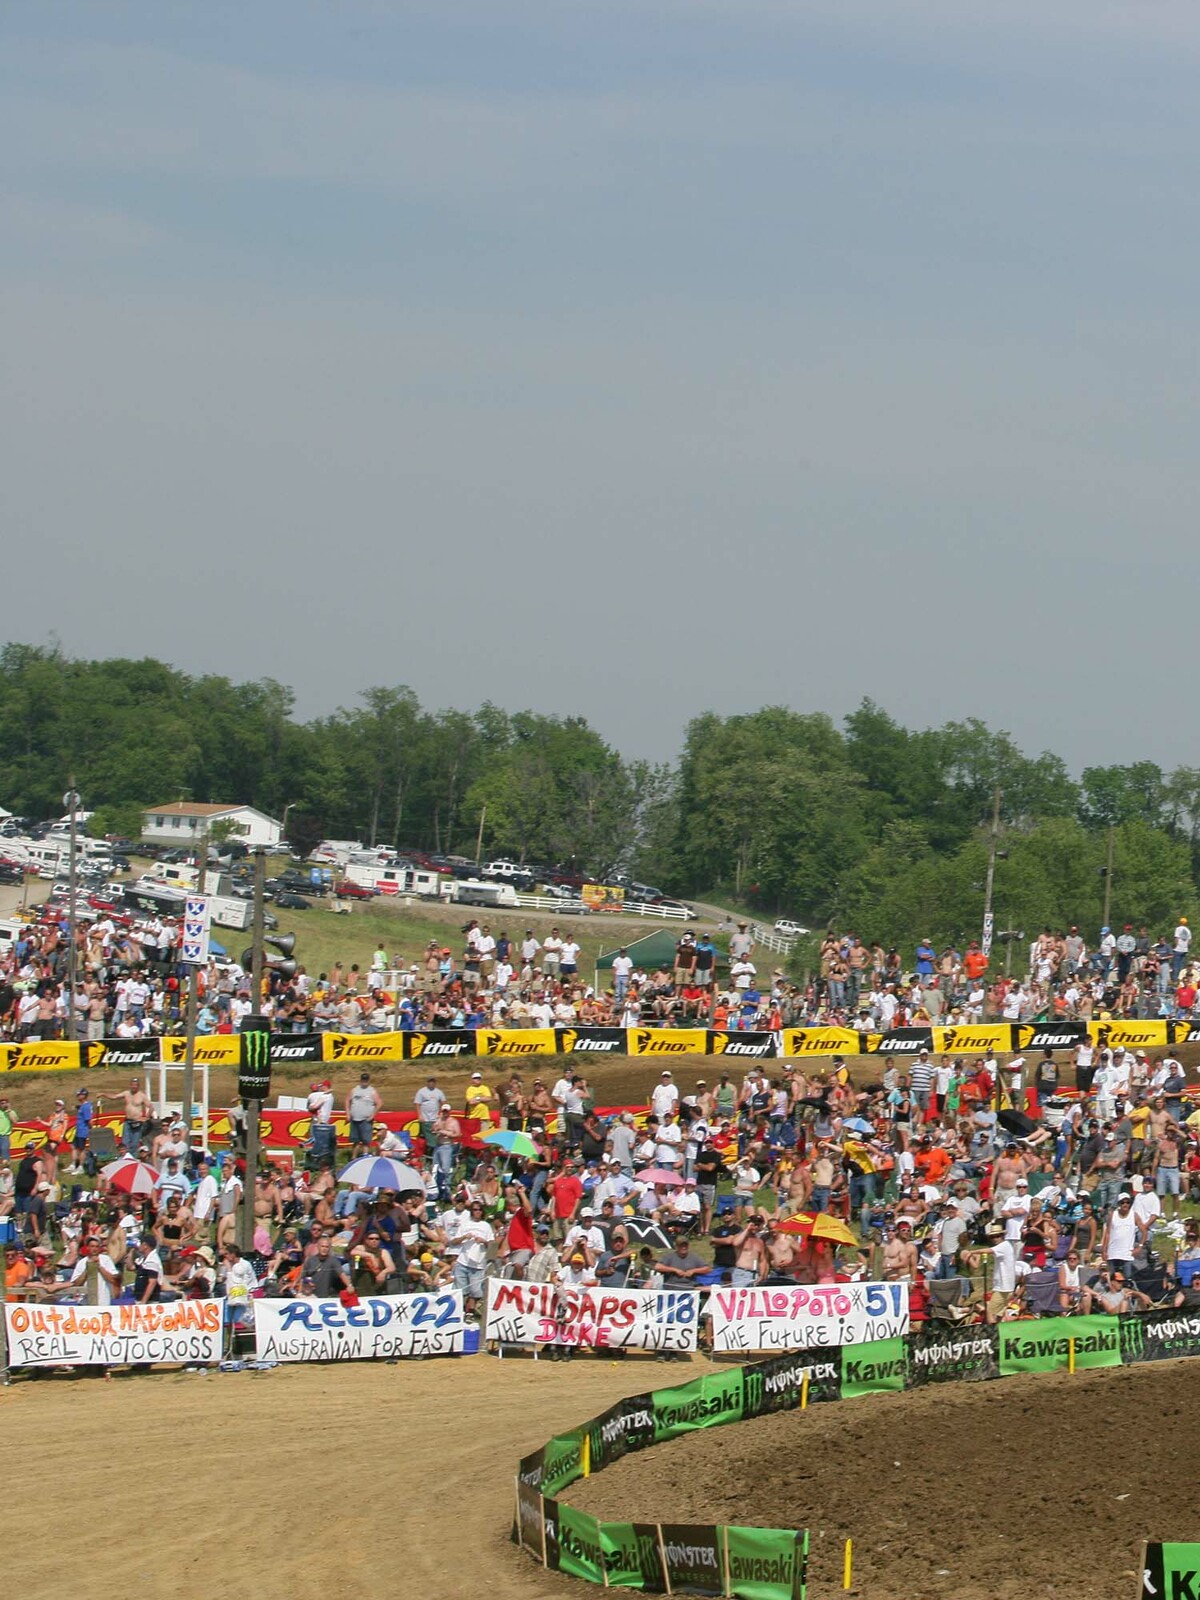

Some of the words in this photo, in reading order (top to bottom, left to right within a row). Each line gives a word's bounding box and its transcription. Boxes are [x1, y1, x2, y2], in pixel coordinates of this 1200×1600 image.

[954, 1036, 1000, 1048] thor
[1032, 1032, 1079, 1046] thor
[1108, 1032, 1157, 1043] thor
[346, 1044, 398, 1057] thor
[423, 1042, 468, 1054] thor
[499, 1040, 545, 1053] thor
[574, 1038, 620, 1051] thor
[648, 1040, 696, 1052] thor
[723, 1041, 770, 1055] thor
[804, 1038, 849, 1051] thor
[880, 1038, 925, 1051] thor
[101, 1050, 152, 1063] thor
[193, 1047, 233, 1059] hor
[22, 1055, 70, 1066] thor
[488, 1316, 527, 1343] THE
[409, 1329, 464, 1356] FAST
[717, 1324, 751, 1350] THE
[1004, 1327, 1117, 1360] Kawasaki
[17, 1335, 78, 1361] REAL
[89, 1335, 213, 1363] MOTOCROSS
[914, 1338, 994, 1365] MONSTER
[764, 1362, 838, 1393] MONSTER
[654, 1386, 741, 1431] Kawasaki
